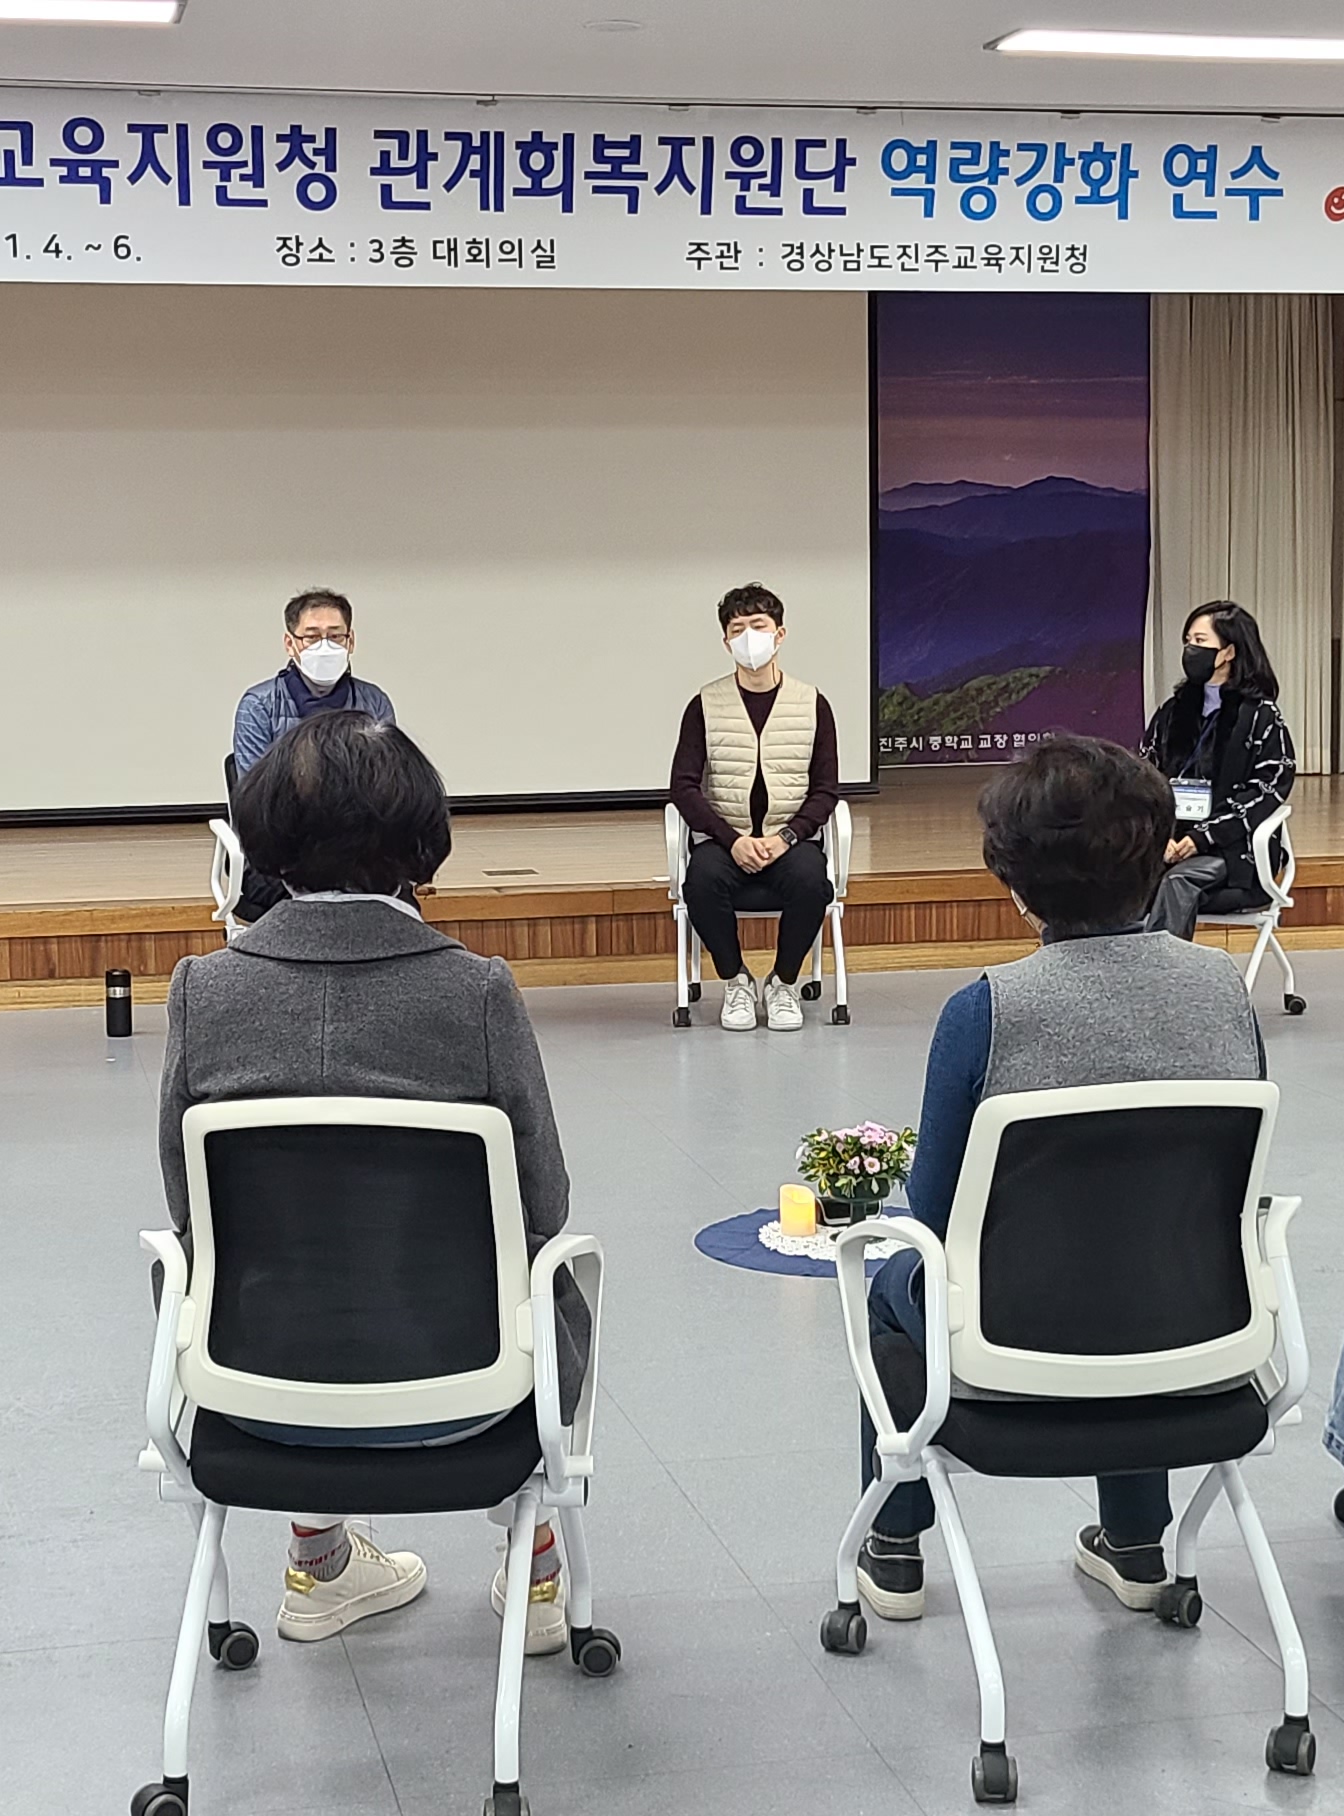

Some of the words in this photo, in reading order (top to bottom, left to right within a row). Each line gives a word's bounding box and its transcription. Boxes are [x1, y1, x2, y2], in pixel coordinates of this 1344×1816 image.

[369, 129, 858, 218] 관계회복지원단
[880, 138, 1140, 223] 역량강화
[1162, 143, 1285, 222] 연수
[275, 235, 336, 267] 장소
[368, 236, 418, 269] 3층
[432, 237, 556, 270] 대회의실
[685, 241, 743, 271] 주관
[781, 241, 1089, 275] 경상남도진주교육지원청
[878, 736, 923, 752] 진주시
[929, 735, 973, 751] 중학교
[978, 734, 1008, 749] 교장
